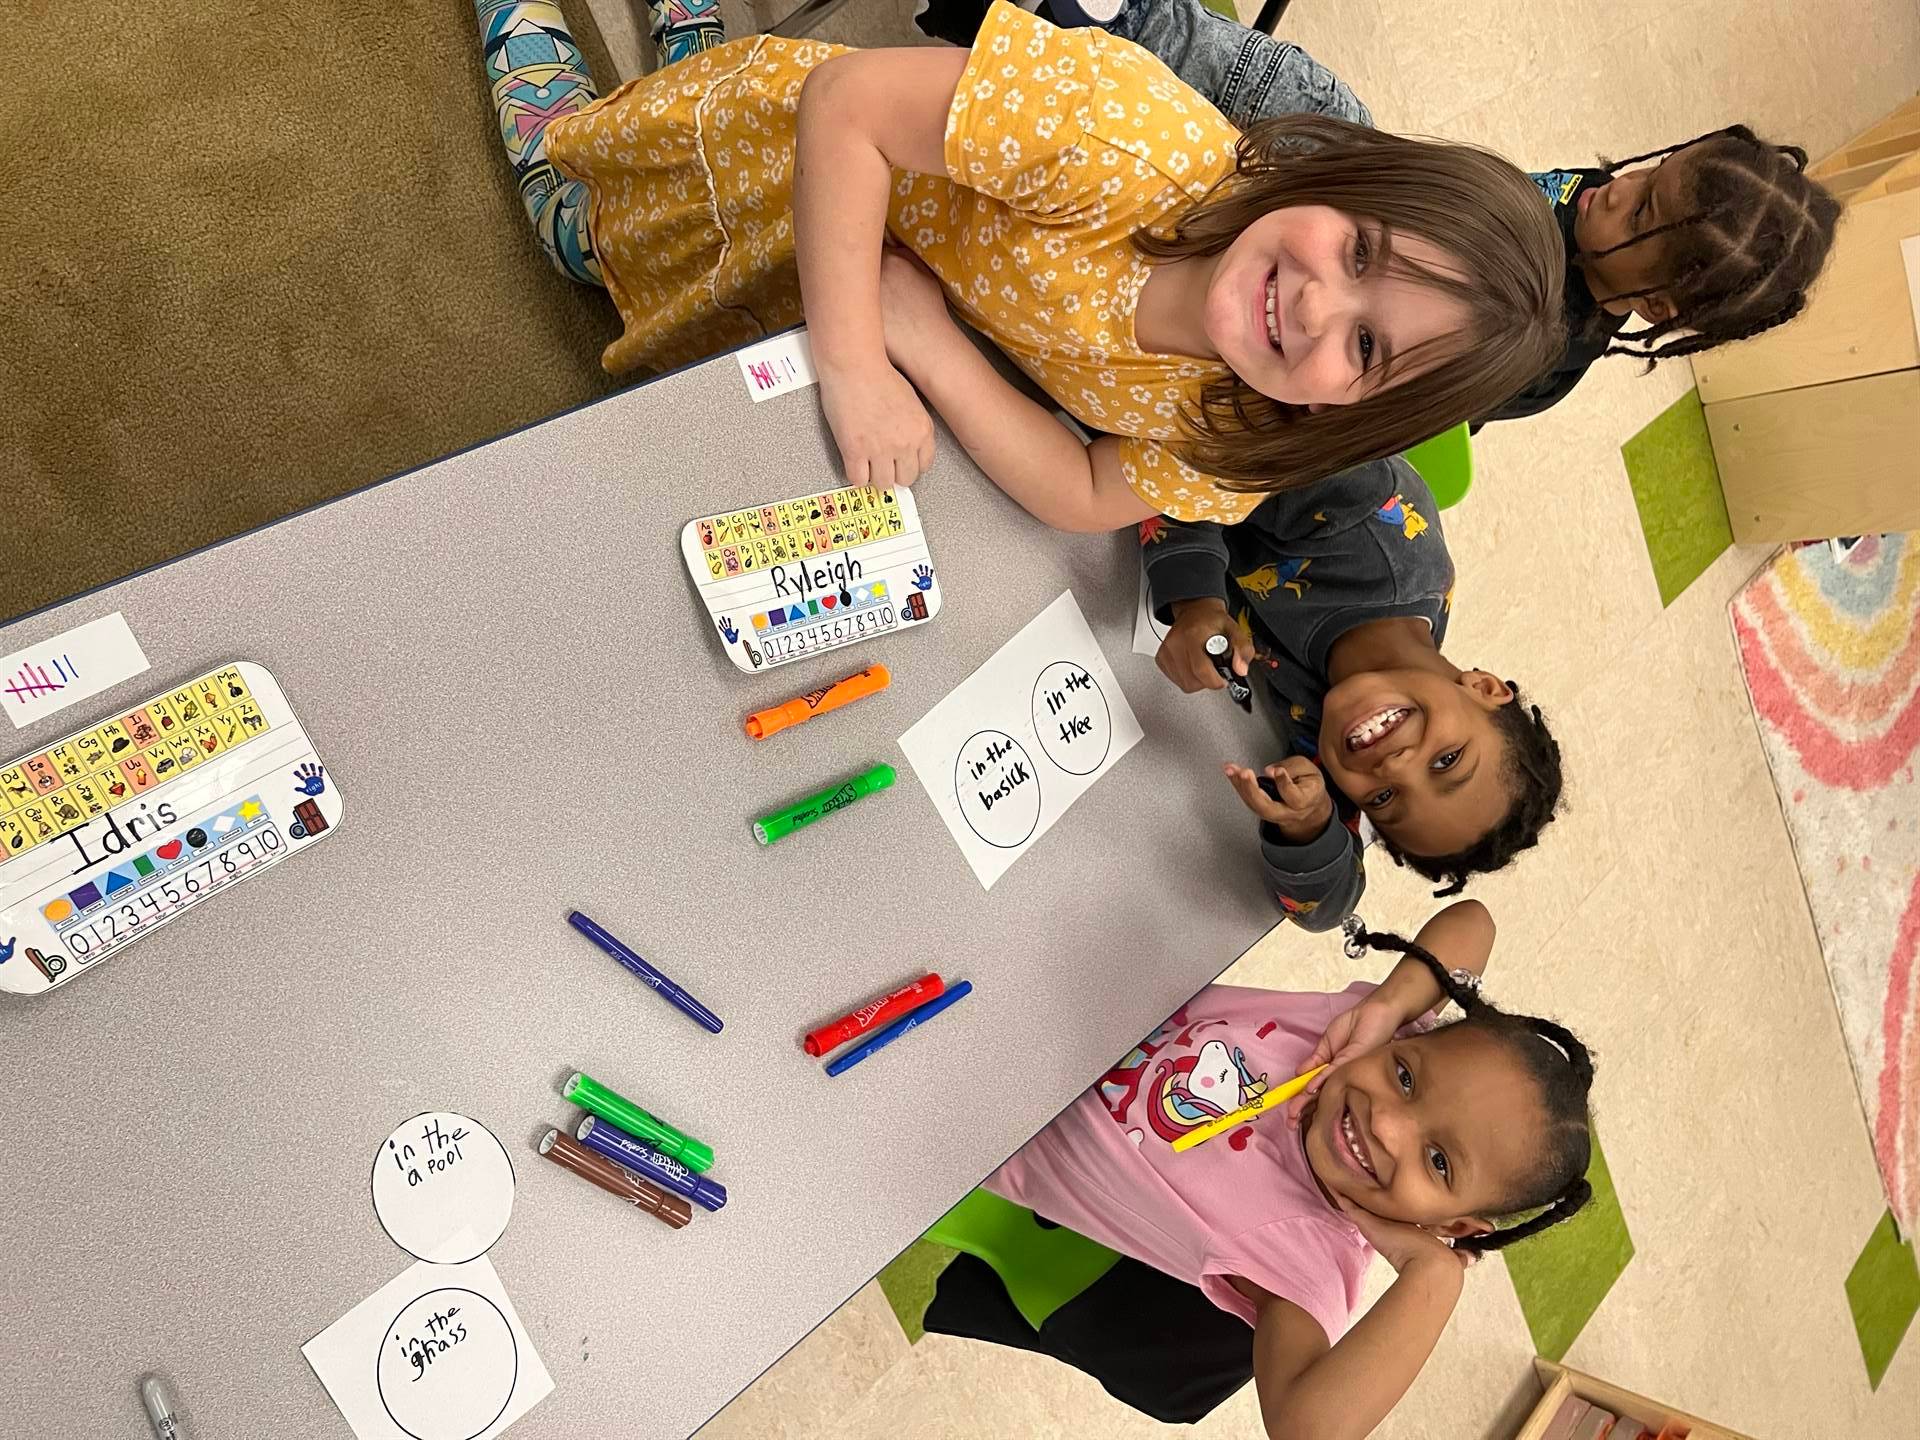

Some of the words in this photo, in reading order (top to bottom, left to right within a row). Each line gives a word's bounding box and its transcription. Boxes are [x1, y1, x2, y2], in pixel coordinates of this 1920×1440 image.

[770, 551, 863, 603] Ryleigh
[764, 641, 774, 659] 0
[776, 638, 783, 656] 1
[784, 635, 794, 653] 2
[795, 632, 805, 649] 3
[807, 627, 818, 645] 4
[820, 624, 831, 642] 5
[834, 621, 843, 639] 6
[844, 618, 852, 635] 7
[856, 614, 865, 632] 8
[867, 611, 878, 628] 9
[878, 606, 894, 625] 10
[1043, 690, 1067, 715] in
[1064, 672, 1091, 693] the
[1, 769, 20, 784] Dd
[27, 760, 44, 772] Ee
[53, 746, 68, 760] Ff
[78, 737, 99, 749] Gg
[102, 725, 120, 738] Hh
[152, 702, 167, 716] Jj
[174, 692, 189, 705] Kk
[217, 671, 238, 684] Mm
[1059, 715, 1093, 744] tree
[50, 795, 65, 807] Rr
[76, 783, 91, 794] Ss
[100, 769, 116, 782] Tt
[124, 759, 141, 771] Uu
[148, 747, 165, 758] Vv
[169, 736, 190, 749] Ww
[194, 725, 211, 737] Xx
[217, 714, 231, 725] Yy
[239, 704, 254, 715] Zz
[967, 760, 987, 780] in
[986, 739, 1013, 763] the
[978, 762, 1030, 811] basick
[48, 802, 178, 875] Idris
[70, 933, 90, 955] 0
[90, 924, 105, 945] 1
[103, 915, 124, 938] 2
[121, 905, 140, 926] 3
[138, 893, 161, 913] 4
[160, 881, 180, 904] 5
[184, 872, 200, 893] 6
[199, 861, 214, 883] 7
[219, 850, 236, 873] 8
[238, 842, 257, 860] 9
[255, 829, 279, 854] 10
[389, 1140, 416, 1171] in
[421, 1119, 470, 1154] the
[395, 1334, 419, 1357] in
[424, 1307, 461, 1337] the
